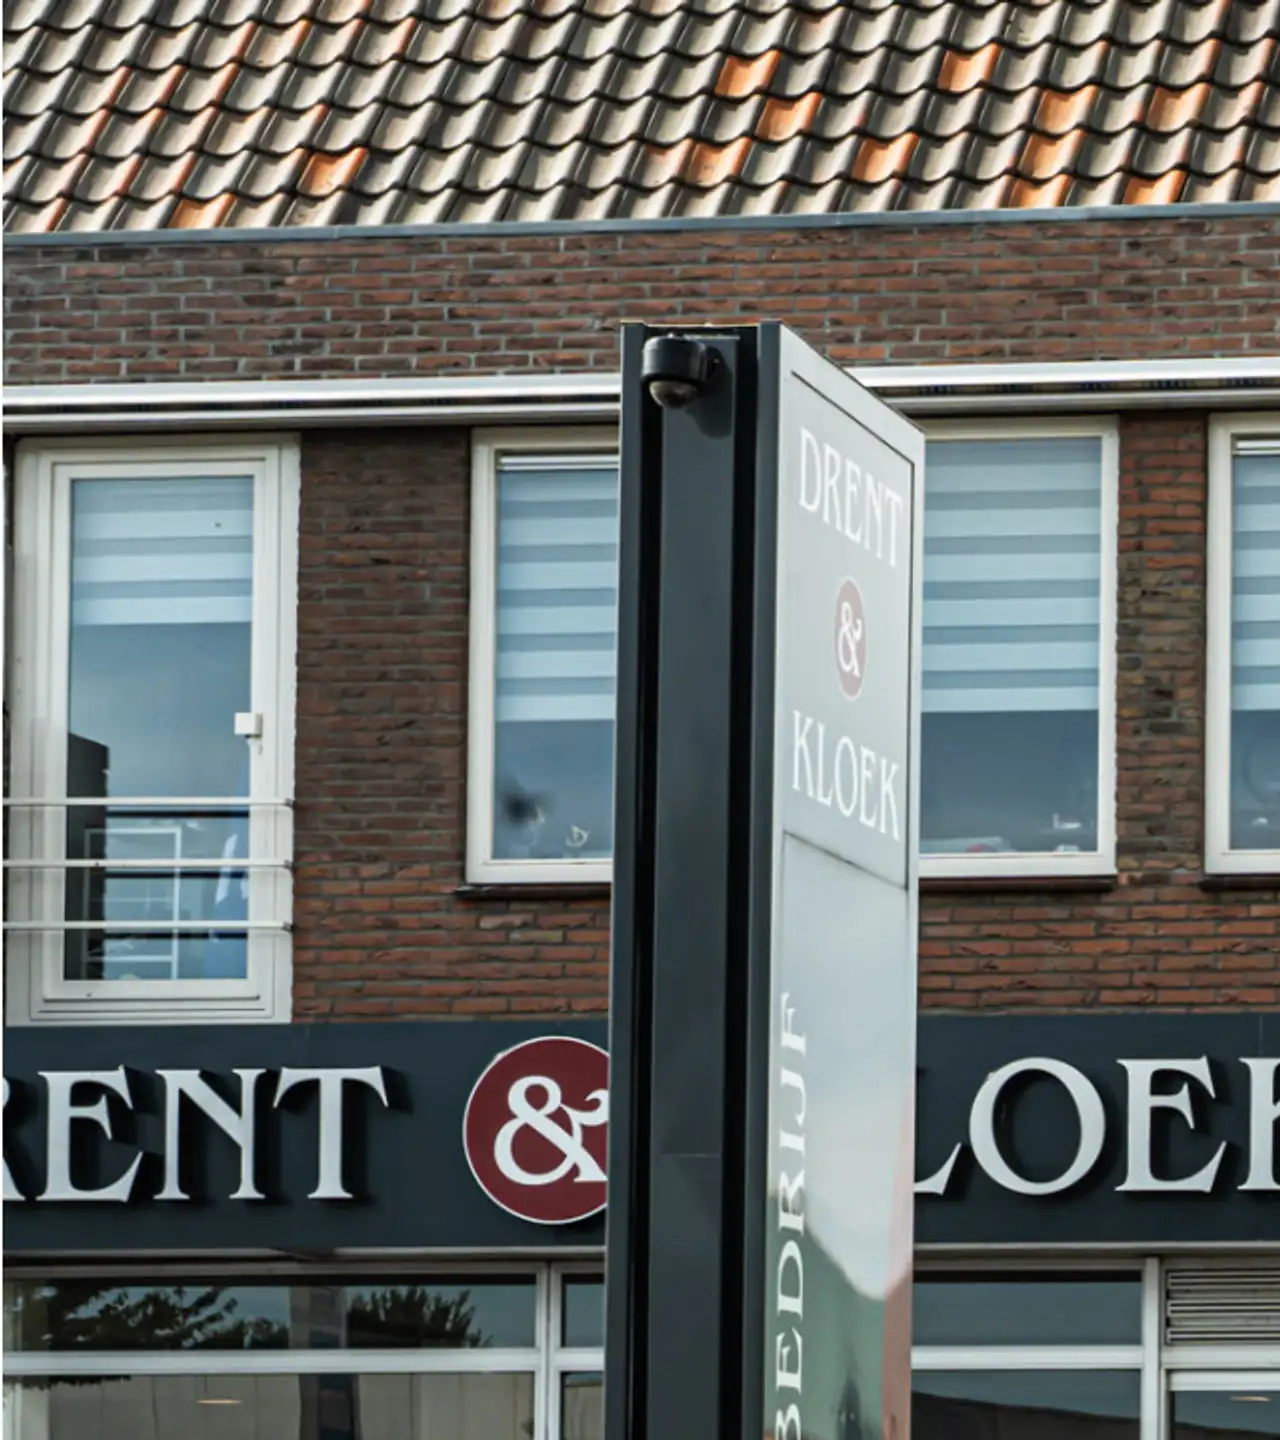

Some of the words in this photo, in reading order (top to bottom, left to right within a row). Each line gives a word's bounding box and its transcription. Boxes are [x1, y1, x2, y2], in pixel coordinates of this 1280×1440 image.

[799, 427, 903, 566] DRENT
[838, 602, 862, 677] &
[792, 711, 900, 841] KLOEK
[3, 1065, 389, 1202] ENT
[493, 1075, 608, 1186] &
